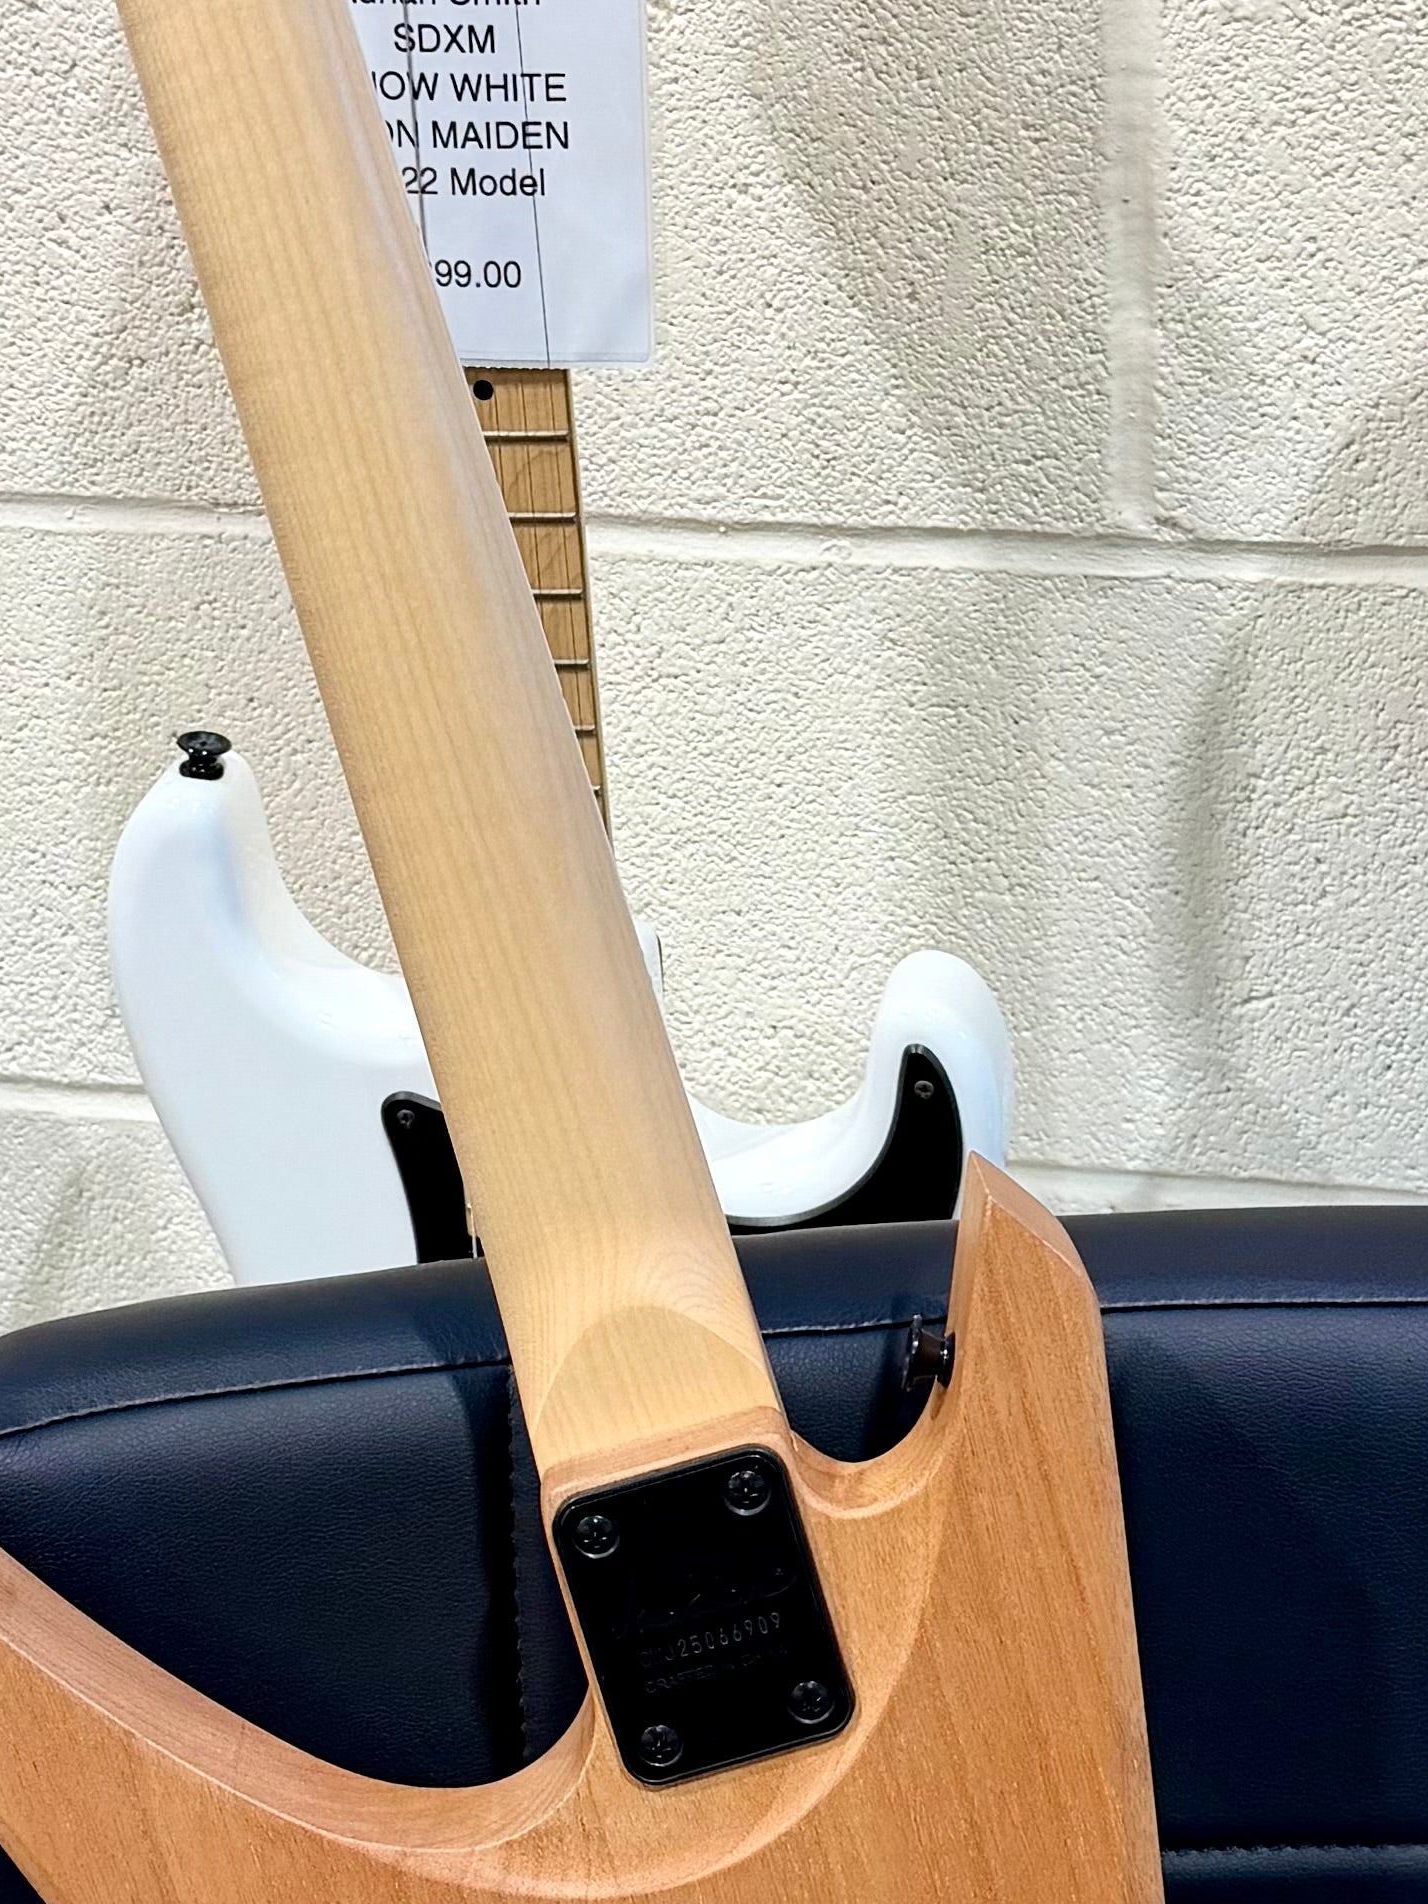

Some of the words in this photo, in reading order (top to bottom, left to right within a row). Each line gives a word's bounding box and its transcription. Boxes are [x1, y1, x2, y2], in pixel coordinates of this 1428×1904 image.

[394, 23, 496, 54] SDXM
[372, 71, 438, 101] OW
[450, 73, 566, 103] WHITE
[432, 119, 569, 150] MAIDEN
[402, 166, 438, 195] 22
[451, 167, 545, 197] Model
